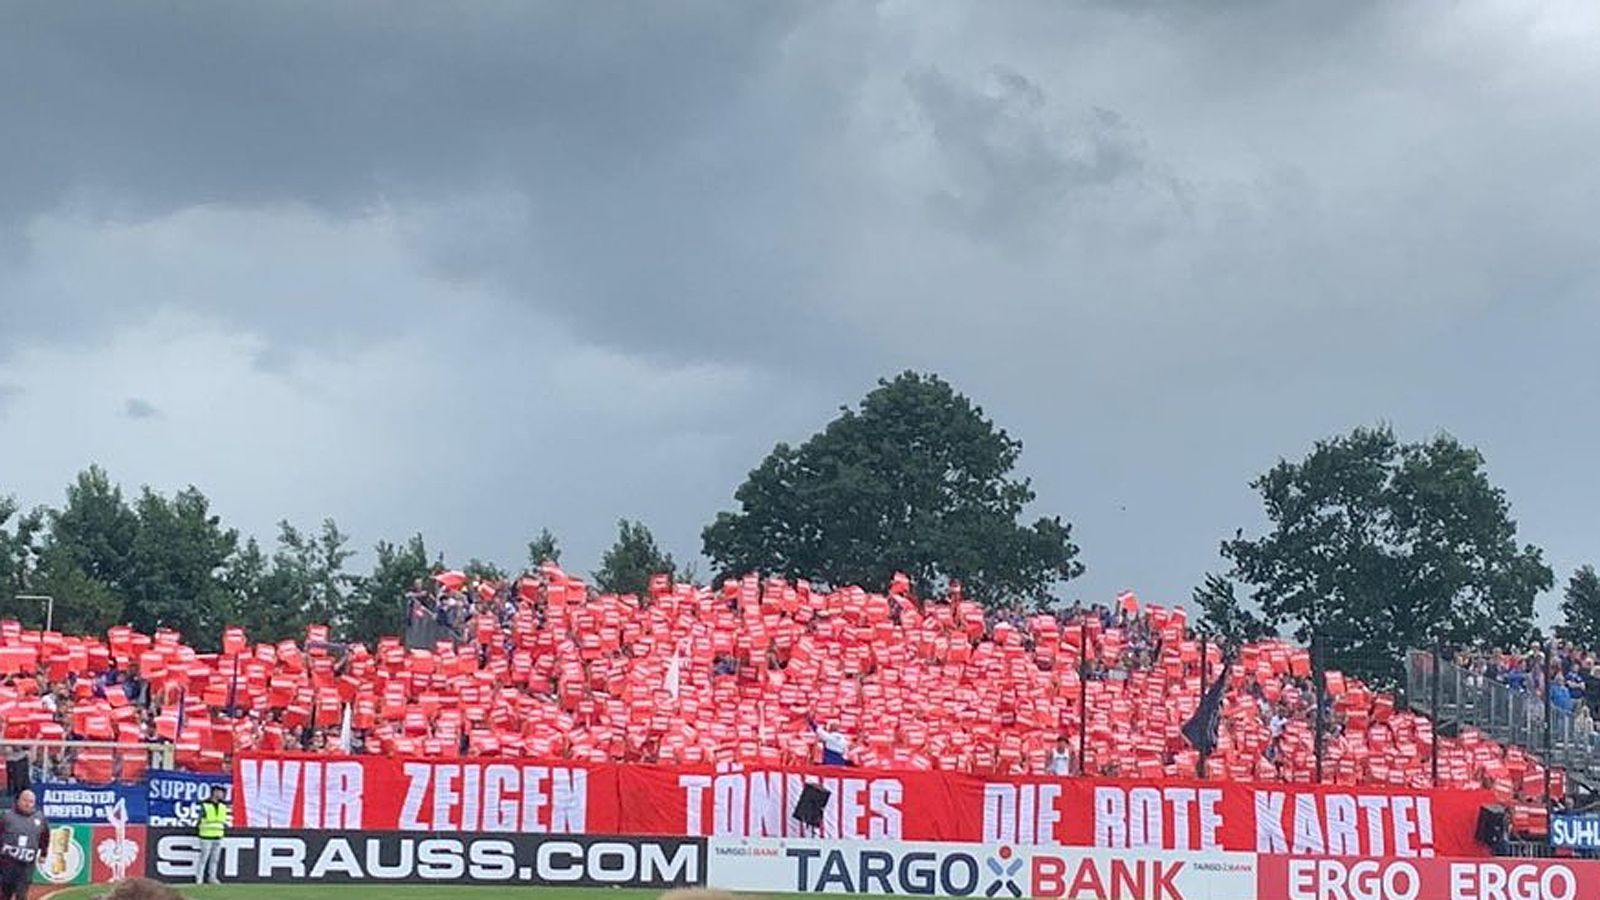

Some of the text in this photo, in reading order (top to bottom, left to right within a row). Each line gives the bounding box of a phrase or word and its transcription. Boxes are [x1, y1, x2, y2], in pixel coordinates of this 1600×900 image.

[43, 789, 115, 803] ALTMEISTER
[149, 778, 233, 800] SUPPOT
[240, 759, 364, 829] WIR
[398, 762, 588, 833] ZEIGEN
[983, 783, 1062, 846] DIE
[1094, 786, 1223, 851] ROTE
[1254, 790, 1435, 858] KARTE!
[157, 835, 698, 882] STRAUSS.COM
[1288, 859, 1420, 900] ERGO
[1450, 863, 1577, 900] ERGO
